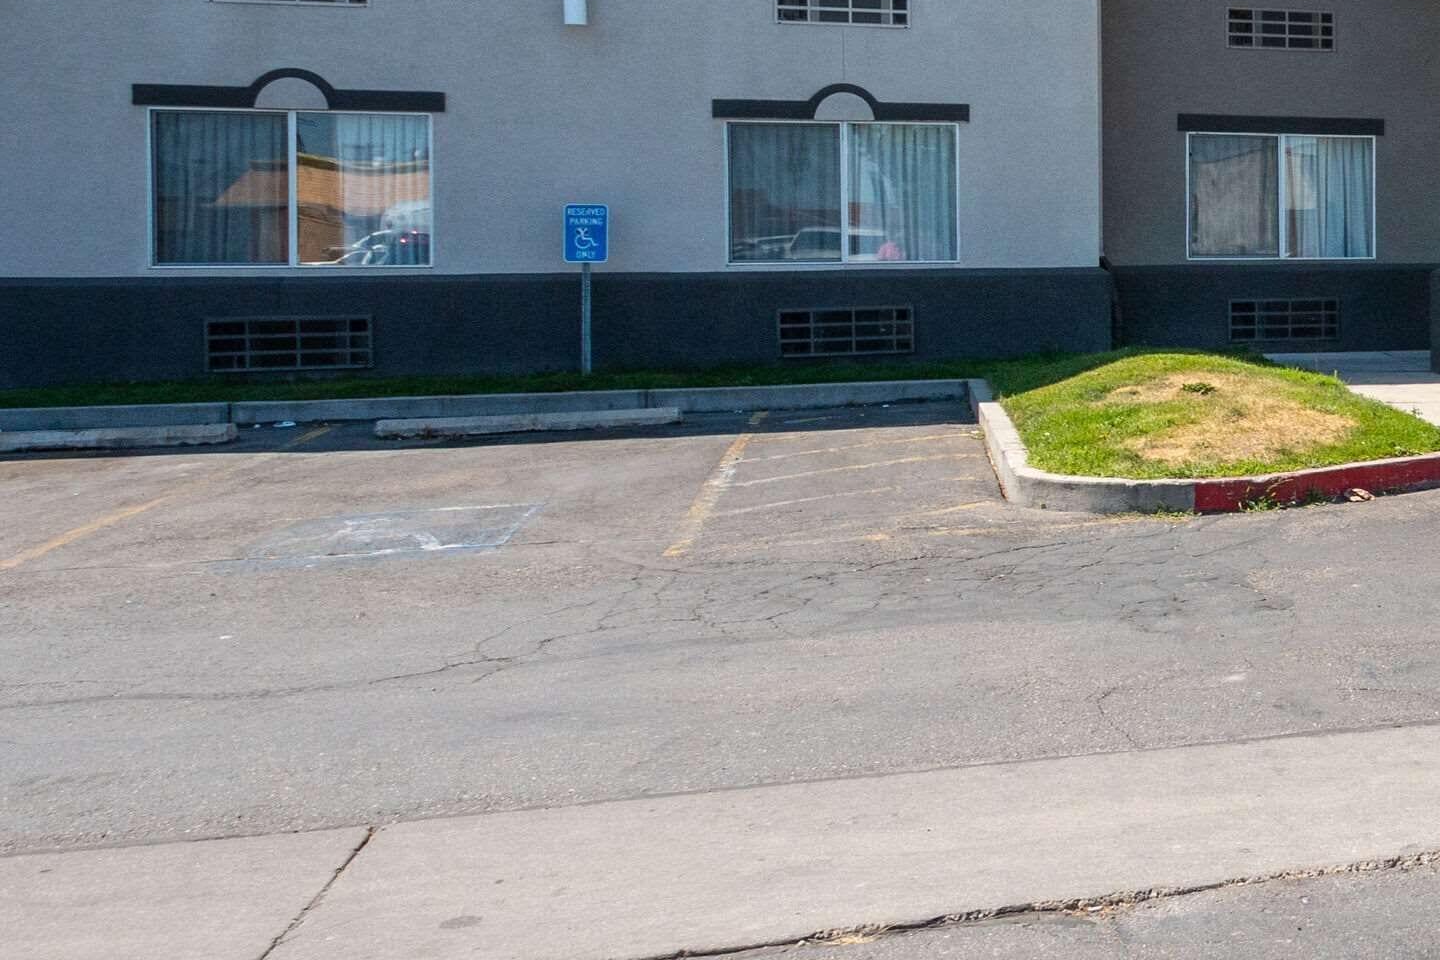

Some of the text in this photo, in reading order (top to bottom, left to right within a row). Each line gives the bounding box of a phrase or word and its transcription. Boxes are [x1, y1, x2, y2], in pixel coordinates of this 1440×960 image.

[567, 207, 605, 216] RESERVED
[569, 217, 603, 225] PARKING
[575, 250, 596, 259] ONLY
